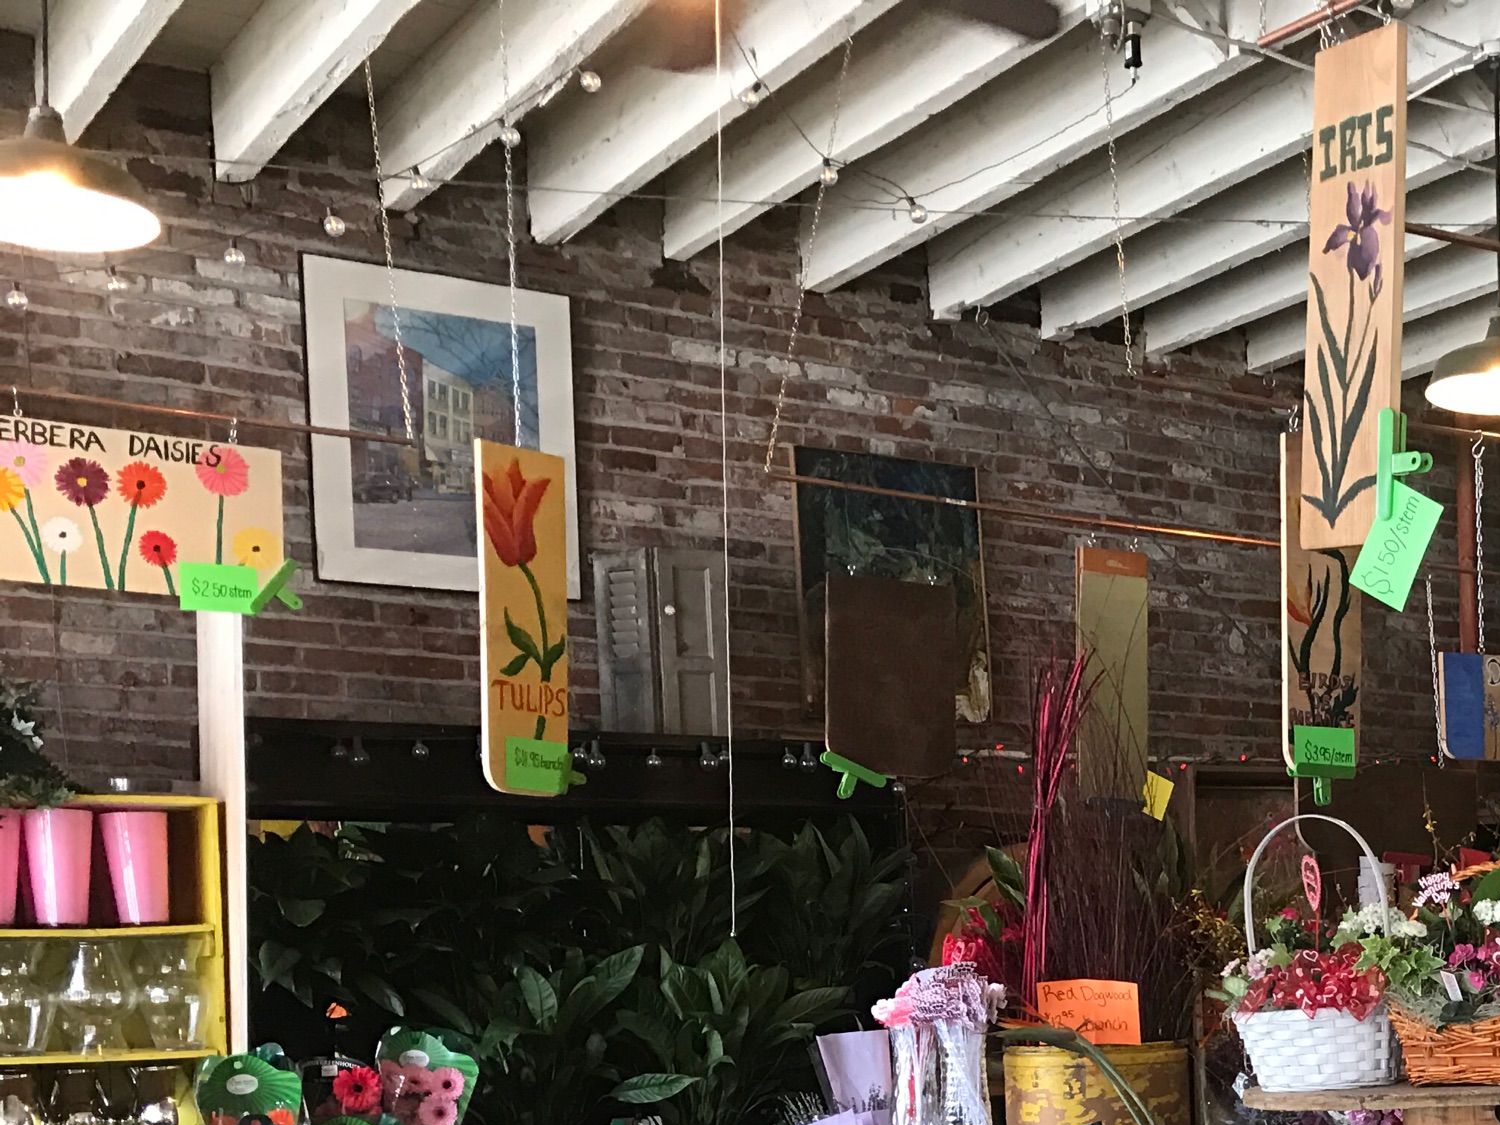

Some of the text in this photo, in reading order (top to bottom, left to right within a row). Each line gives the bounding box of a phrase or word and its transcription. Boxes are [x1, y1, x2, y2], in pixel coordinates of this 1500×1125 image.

[1318, 104, 1396, 183] IRIS
[0, 418, 223, 468] ERBERA DAISIES
[228, 581, 252, 599] stem
[1298, 671, 1353, 691] BIRDS
[490, 679, 567, 717] TULIPS
[1417, 871, 1450, 889] Happy
[1411, 878, 1460, 908] Valentine's
[1431, 891, 1451, 904] Day
[1042, 984, 1133, 1007] Red Dogwood
